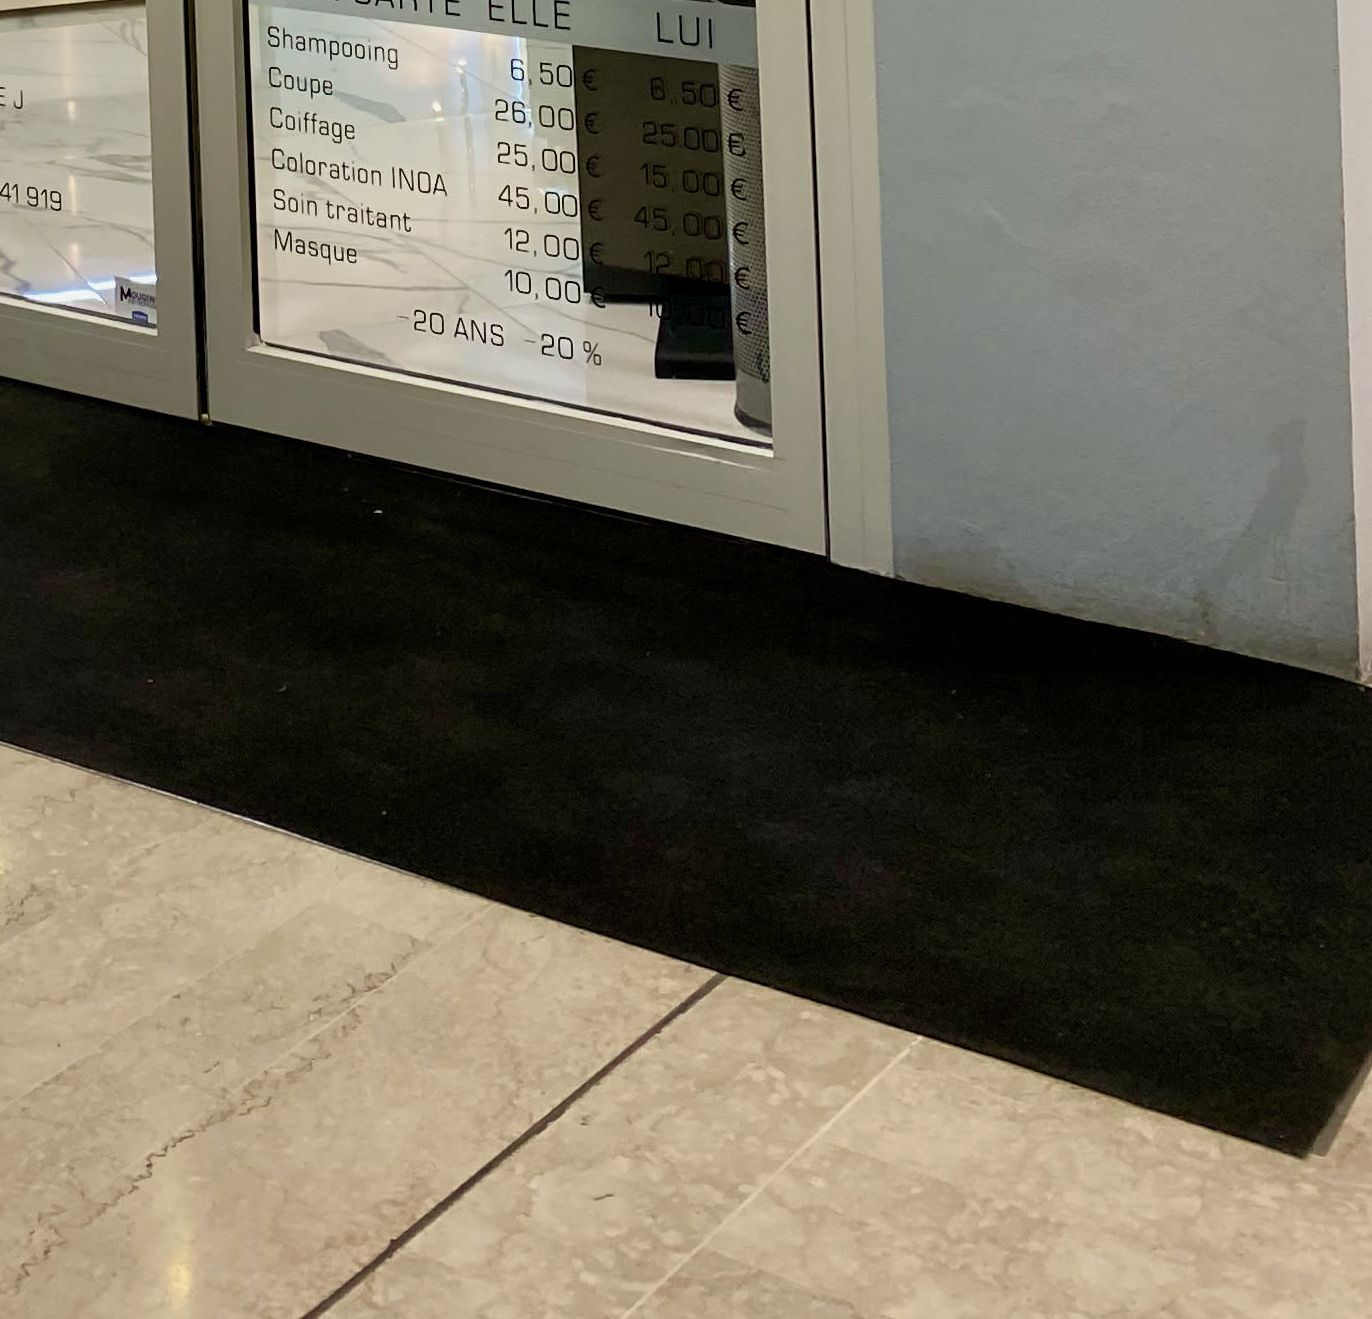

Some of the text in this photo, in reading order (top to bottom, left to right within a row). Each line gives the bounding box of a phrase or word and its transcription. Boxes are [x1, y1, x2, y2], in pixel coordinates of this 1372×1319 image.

[266, 25, 399, 70] Shampooing
[510, 58, 573, 88] 6,50
[583, 68, 598, 91] €
[728, 88, 743, 111] €
[657, 11, 714, 50] LUI
[268, 66, 334, 98] Coupe
[495, 99, 575, 131] 26,00
[584, 113, 599, 134] €
[728, 133, 746, 157] €
[269, 107, 356, 143] Coiffage
[497, 141, 576, 174] 25,00
[586, 156, 601, 178] €
[731, 178, 747, 201] €
[27, 186, 63, 212] 919
[271, 148, 383, 189] Coloration
[391, 170, 448, 197] INOA
[498, 184, 578, 218] 45,00
[588, 199, 603, 221] €
[733, 221, 749, 244] €
[272, 189, 318, 217] Soin
[326, 198, 412, 234] traitant
[504, 228, 580, 261] 12,00
[589, 242, 605, 265] €
[734, 267, 751, 290] €
[273, 230, 358, 265] Masque
[504, 269, 581, 304] 10,00
[590, 286, 606, 309] €
[736, 312, 752, 335] €
[454, 316, 504, 348] ANS
[583, 341, 602, 368] %
